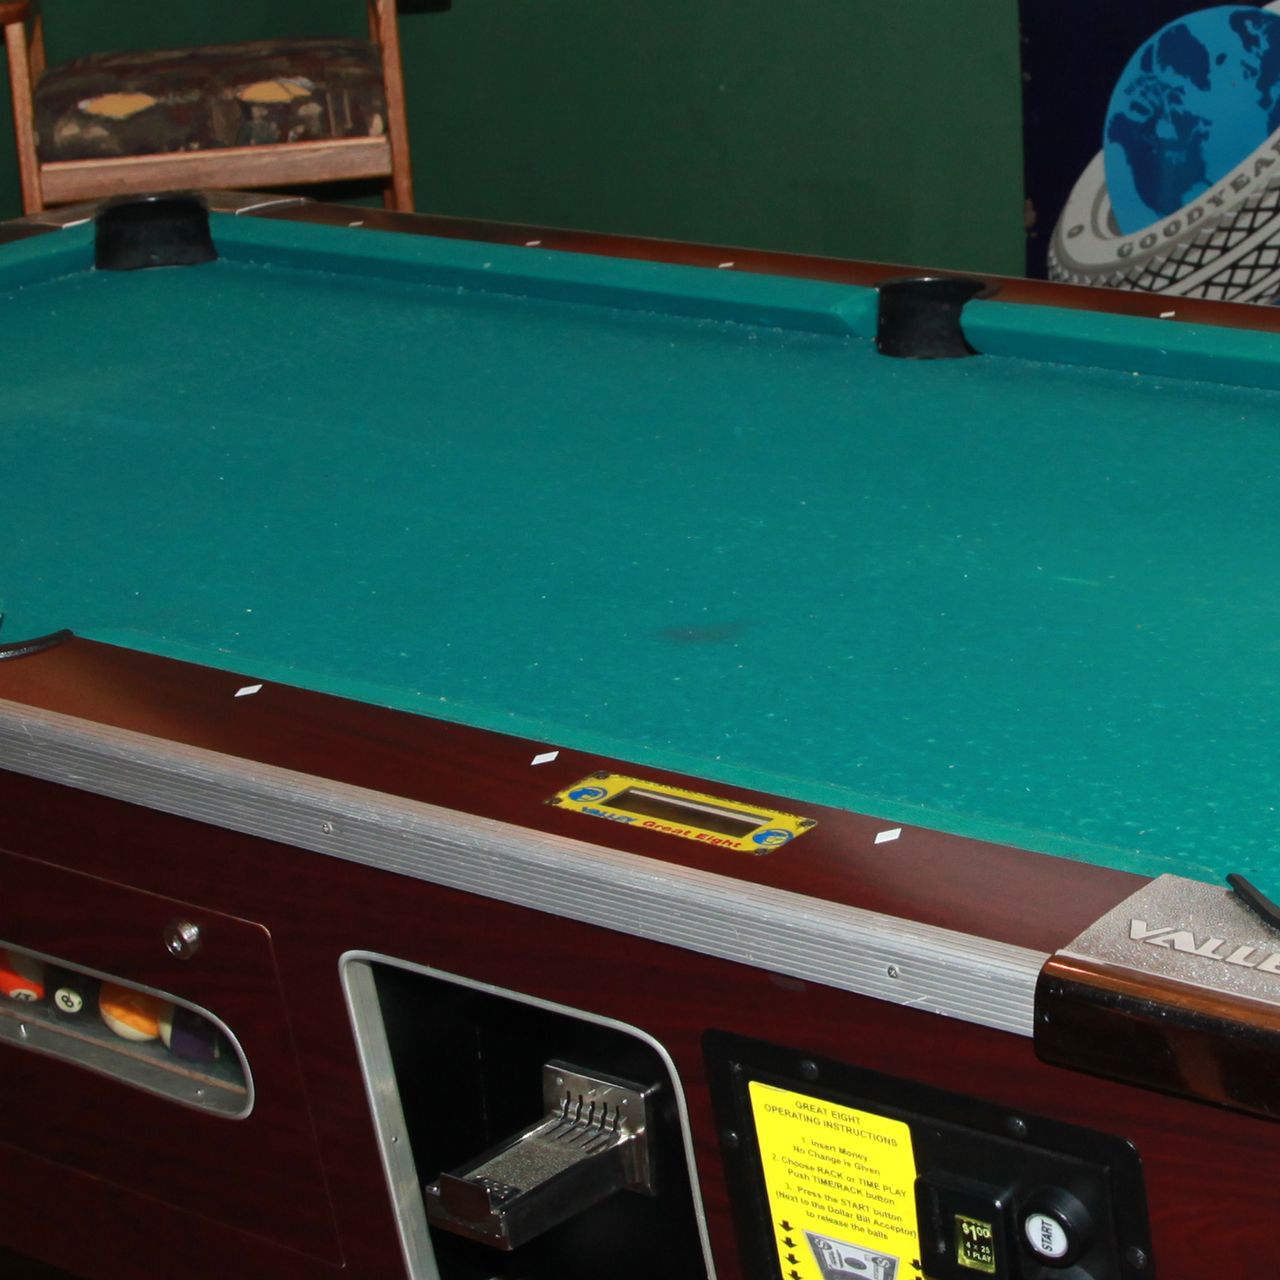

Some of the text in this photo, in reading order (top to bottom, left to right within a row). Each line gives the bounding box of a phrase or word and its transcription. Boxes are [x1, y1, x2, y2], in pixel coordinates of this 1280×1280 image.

[642, 820, 692, 837] Great
[696, 832, 743, 851] Eight
[764, 1103, 899, 1148] OPERATING INSTRUCTIONS
[795, 1100, 861, 1125] GREAT EIGHT
[793, 1144, 806, 1155] No
[807, 1148, 842, 1166] Change
[853, 1161, 881, 1177] Given
[810, 1138, 836, 1152] Insert
[838, 1146, 868, 1163] Money
[781, 1155, 816, 1172] Choose
[817, 1165, 844, 1180] RACK
[846, 1175, 856, 1183] or
[857, 1177, 881, 1191] TIME
[882, 1184, 907, 1199] PLAY
[787, 1168, 896, 1206] Push TIME/RACK button
[775, 1189, 918, 1240] (Next to the Dollar Bill Acceptor)
[797, 1185, 823, 1200] Press
[823, 1193, 839, 1205] the
[840, 1197, 871, 1213] START
[872, 1207, 904, 1223] button
[805, 1209, 890, 1242] to release the balls
[1041, 1219, 1053, 1252] START
[972, 1251, 992, 1263] PLAY
